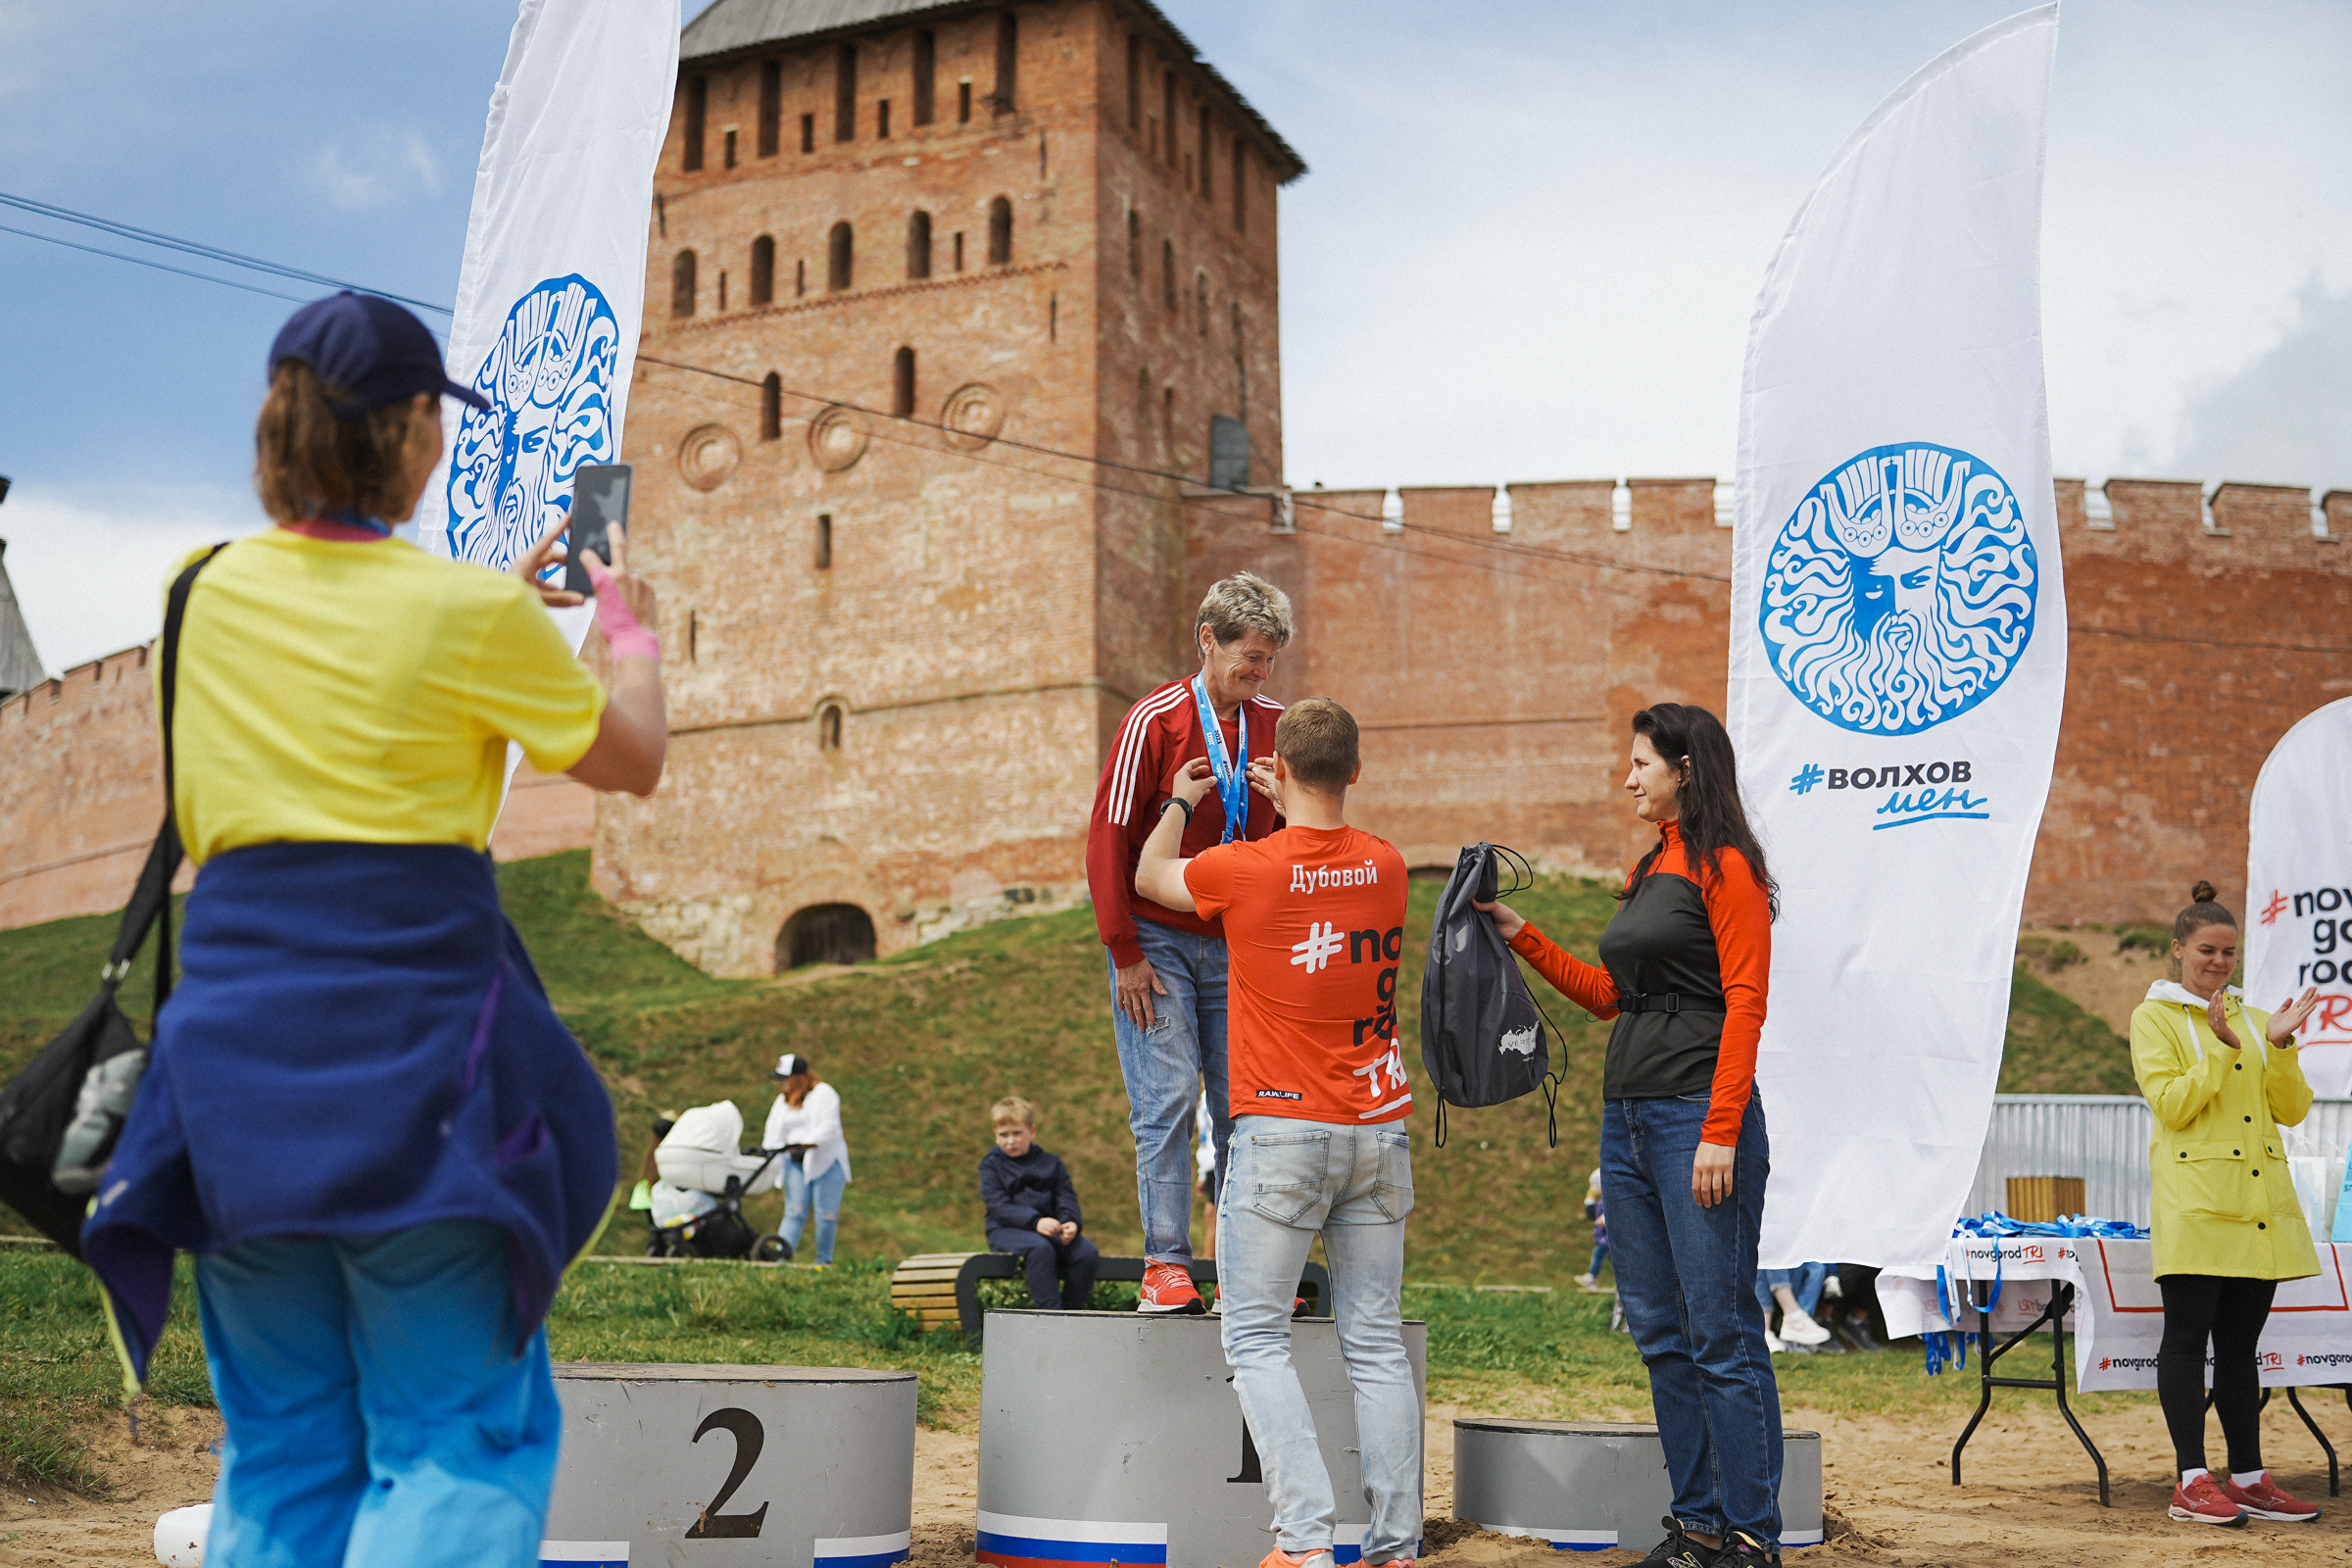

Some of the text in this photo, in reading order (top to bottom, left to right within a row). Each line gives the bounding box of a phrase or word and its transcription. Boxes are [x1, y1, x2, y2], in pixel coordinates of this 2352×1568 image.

[1788, 761, 1972, 796] #ВОЛХОВ
[1876, 787, 1988, 814] мен
[1290, 858, 1378, 895] Дубовой
[2297, 1353, 2352, 1367] #novgoro
[684, 1407, 769, 1539] 2
